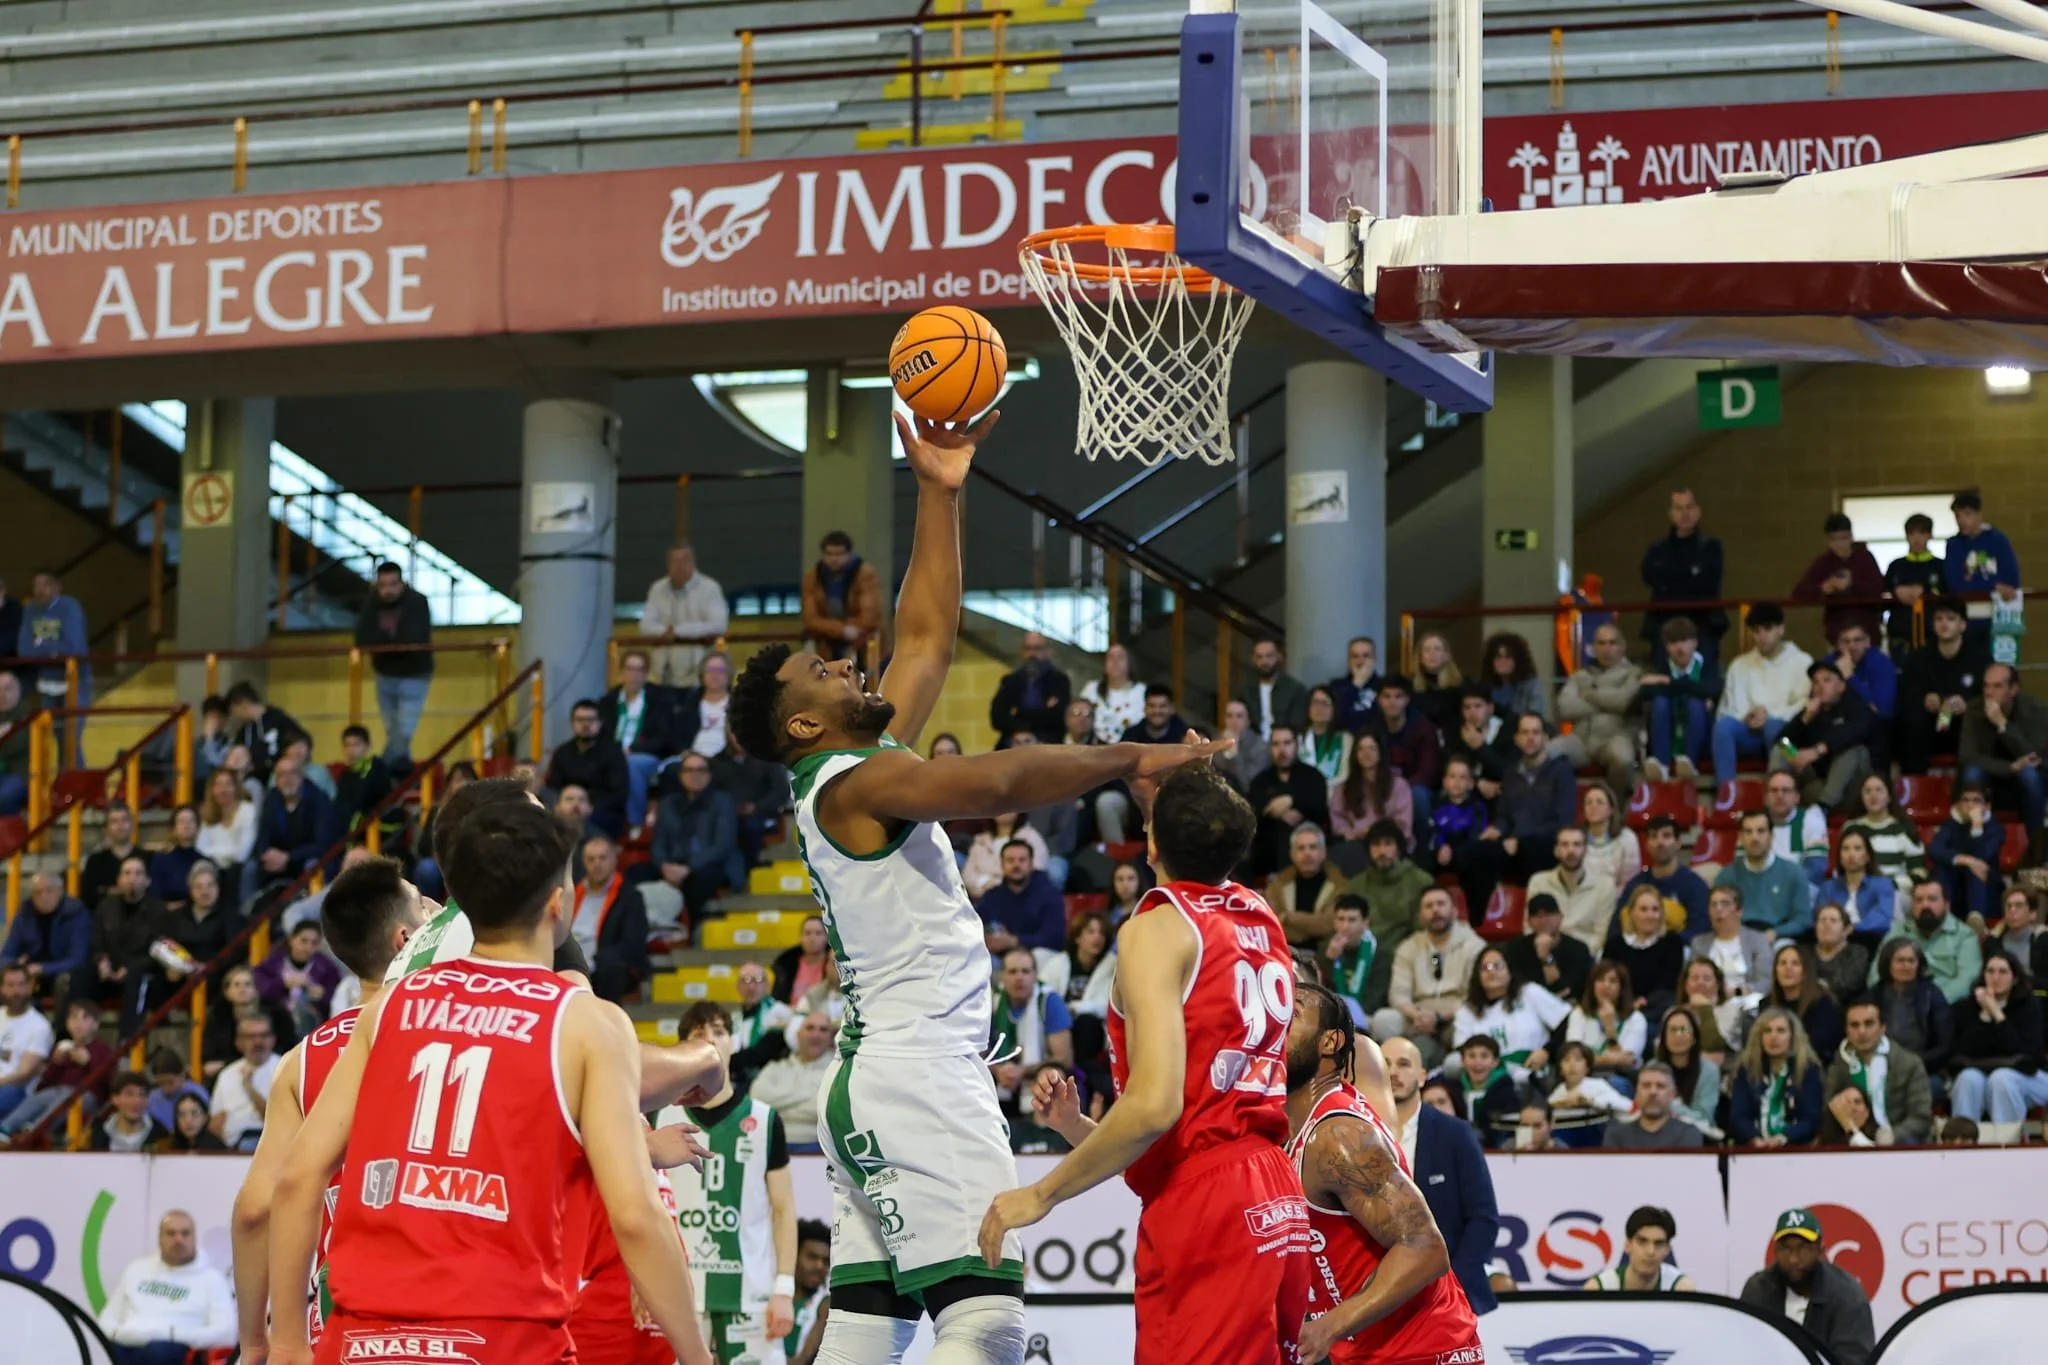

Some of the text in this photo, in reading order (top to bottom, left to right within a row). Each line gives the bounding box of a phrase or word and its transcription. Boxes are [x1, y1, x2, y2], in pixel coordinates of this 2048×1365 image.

[1639, 133, 1882, 187] AYUNTAMIENTO
[8, 199, 382, 257] MUNICIPAL DEPORTES
[79, 244, 434, 344] ALEGRE
[662, 286, 777, 312] Instituto
[785, 273, 925, 307] Municipal
[932, 271, 971, 298] de
[1720, 378, 1757, 419] D
[1234, 959, 1295, 1055] 99
[408, 1041, 493, 1157] 11
[402, 1163, 509, 1213] IXMA
[679, 1202, 740, 1232] coto
[1900, 1219, 2048, 1259] GESTO
